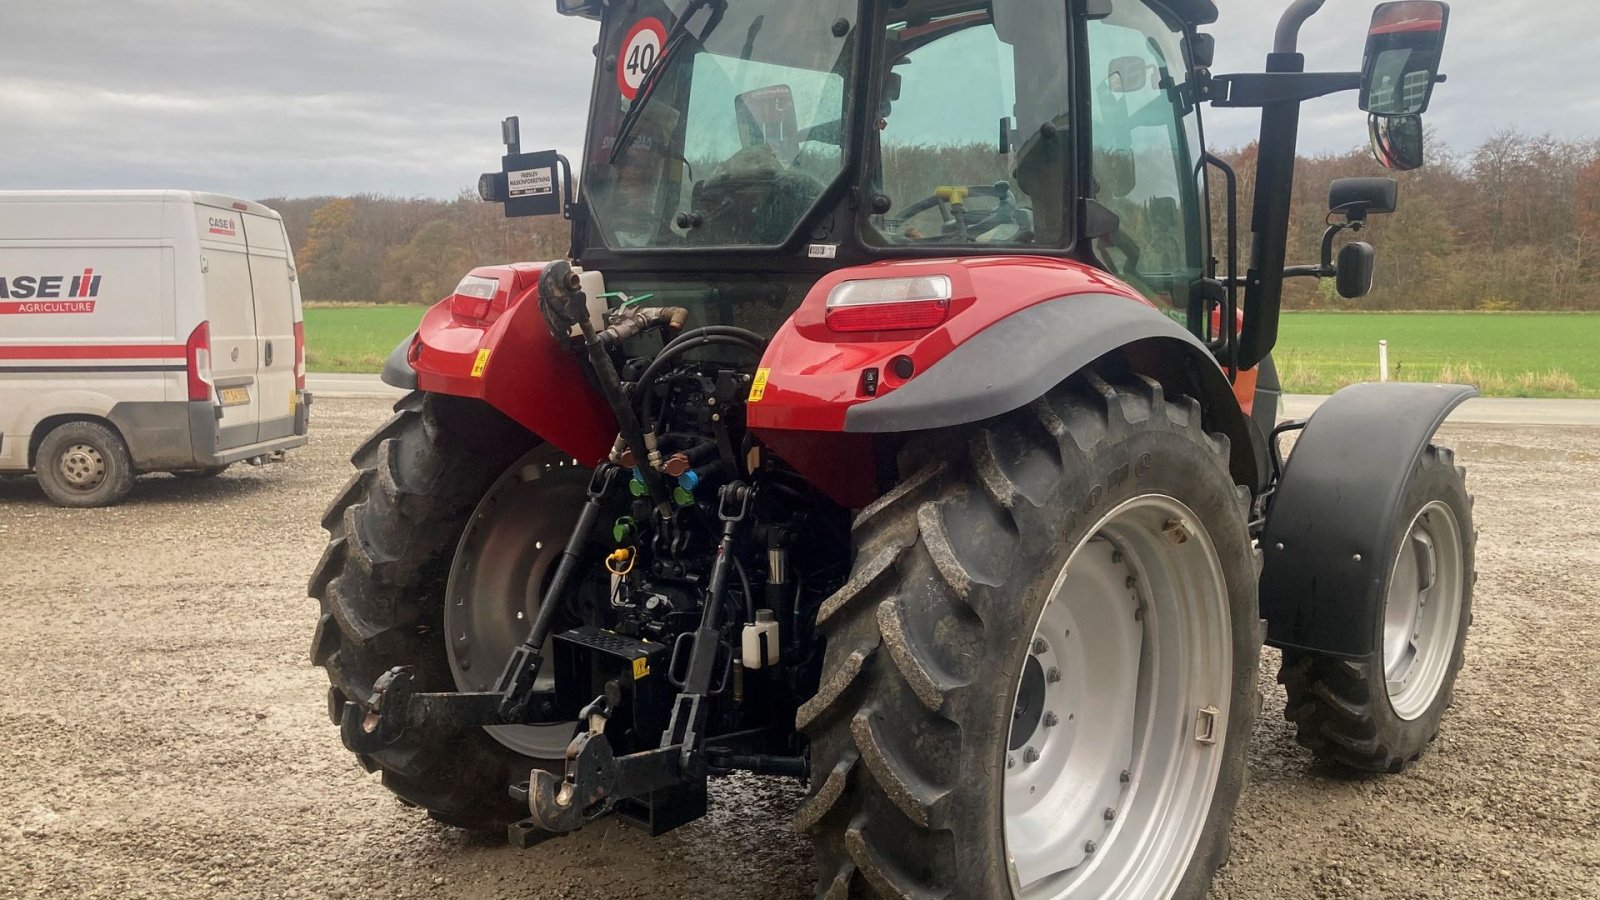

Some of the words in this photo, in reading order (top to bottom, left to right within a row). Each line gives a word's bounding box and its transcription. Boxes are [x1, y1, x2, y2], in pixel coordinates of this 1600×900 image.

[626, 43, 655, 75] 40
[208, 217, 228, 228] CASE
[0, 275, 63, 299] SE
[18, 302, 92, 313] AGRICULTURE
